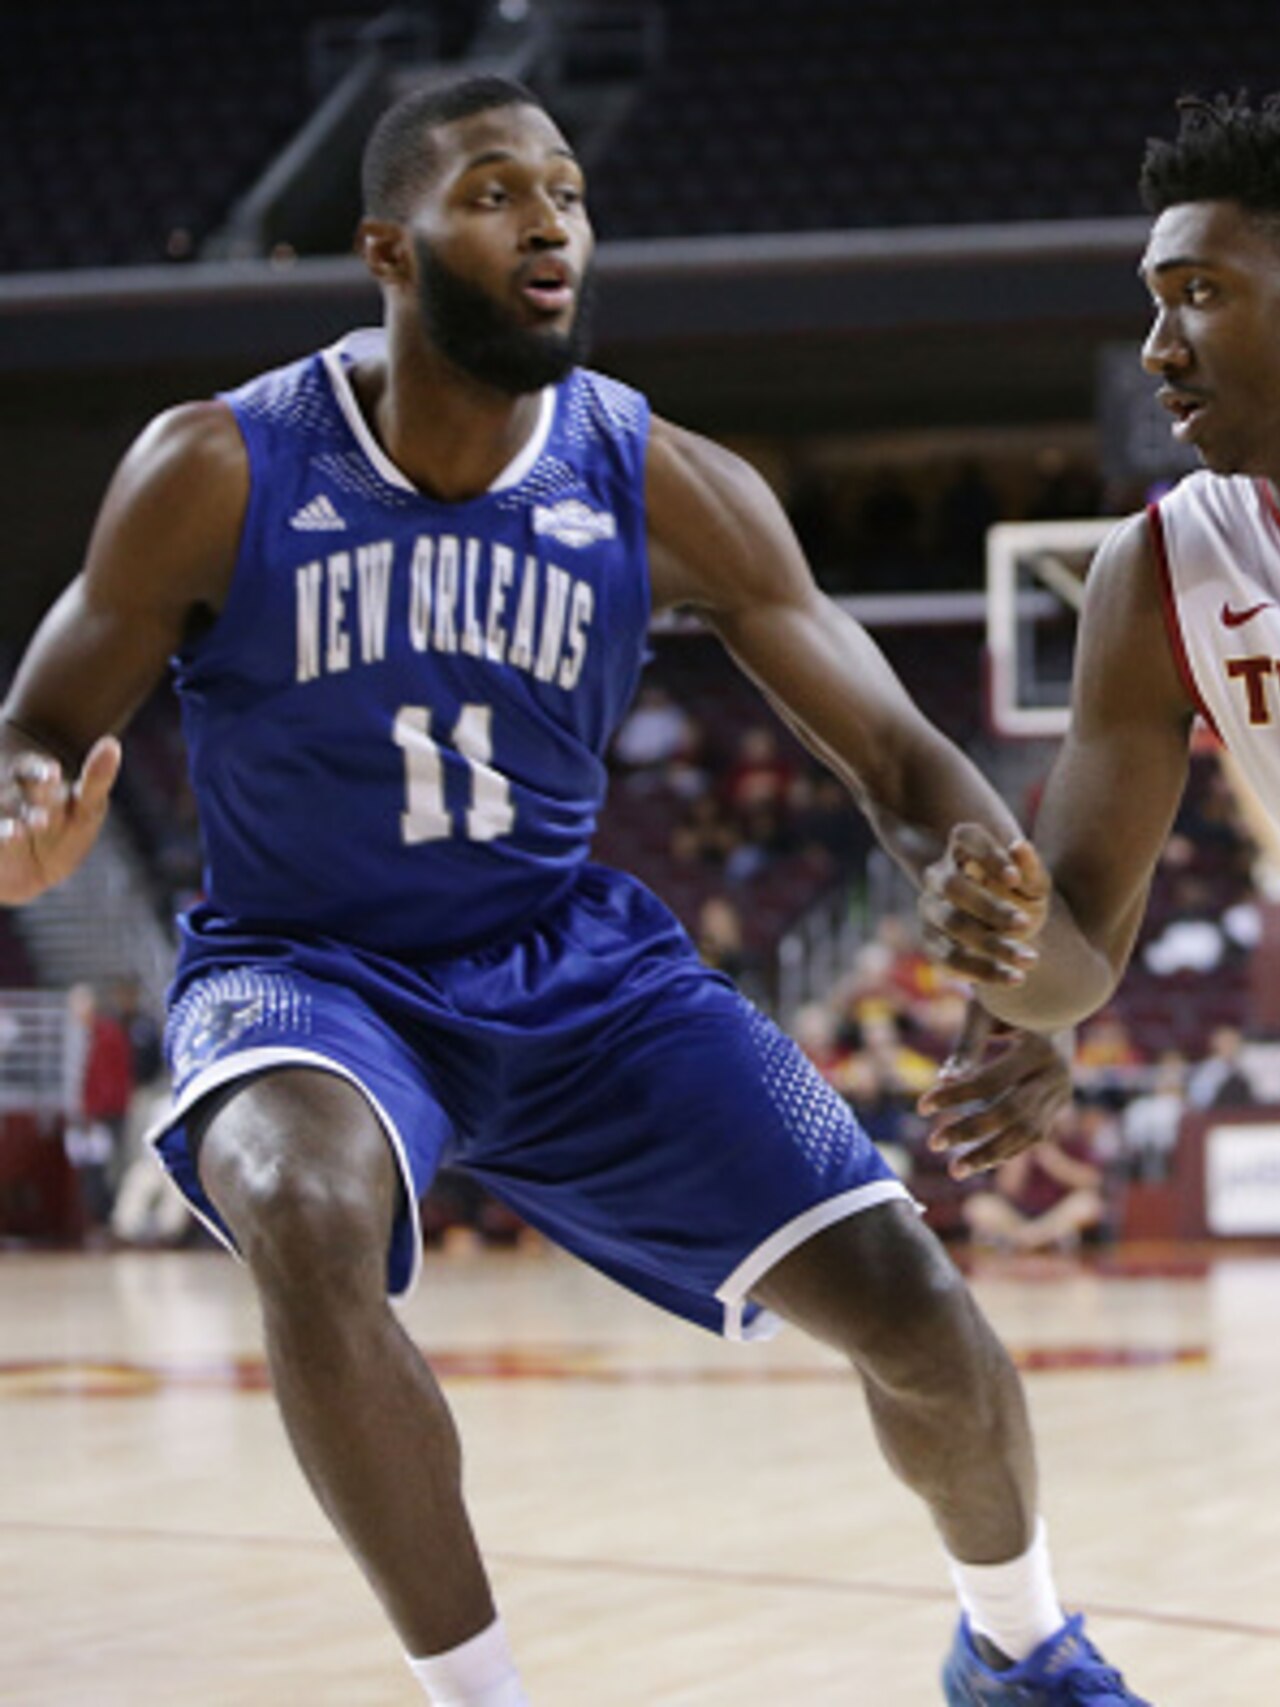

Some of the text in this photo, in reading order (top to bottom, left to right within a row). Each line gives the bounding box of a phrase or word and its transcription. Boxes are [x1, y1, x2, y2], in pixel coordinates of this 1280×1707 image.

[296, 535, 594, 690] NEW ORLEANS
[393, 704, 514, 844] 11
